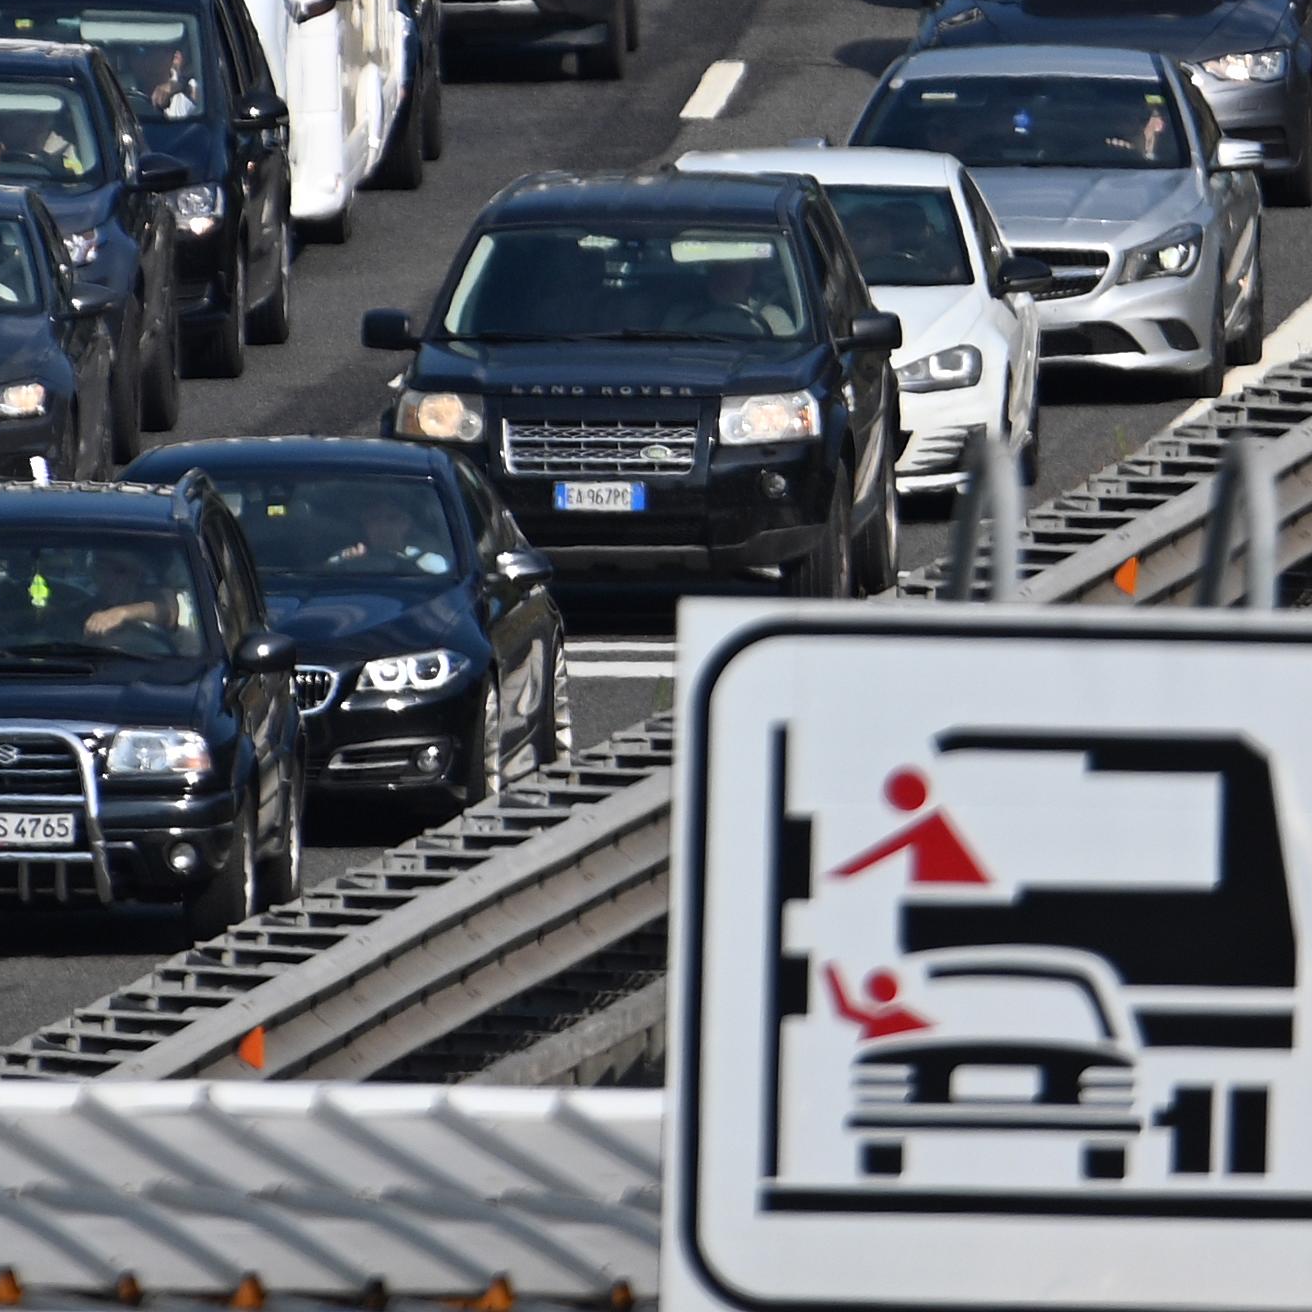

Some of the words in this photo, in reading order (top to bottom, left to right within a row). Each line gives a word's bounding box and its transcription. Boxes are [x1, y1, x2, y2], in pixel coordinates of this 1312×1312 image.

[511, 384, 585, 395] LAND
[601, 385, 692, 396] ROVER
[588, 487, 630, 505] 967PC
[14, 817, 69, 837] 4765
